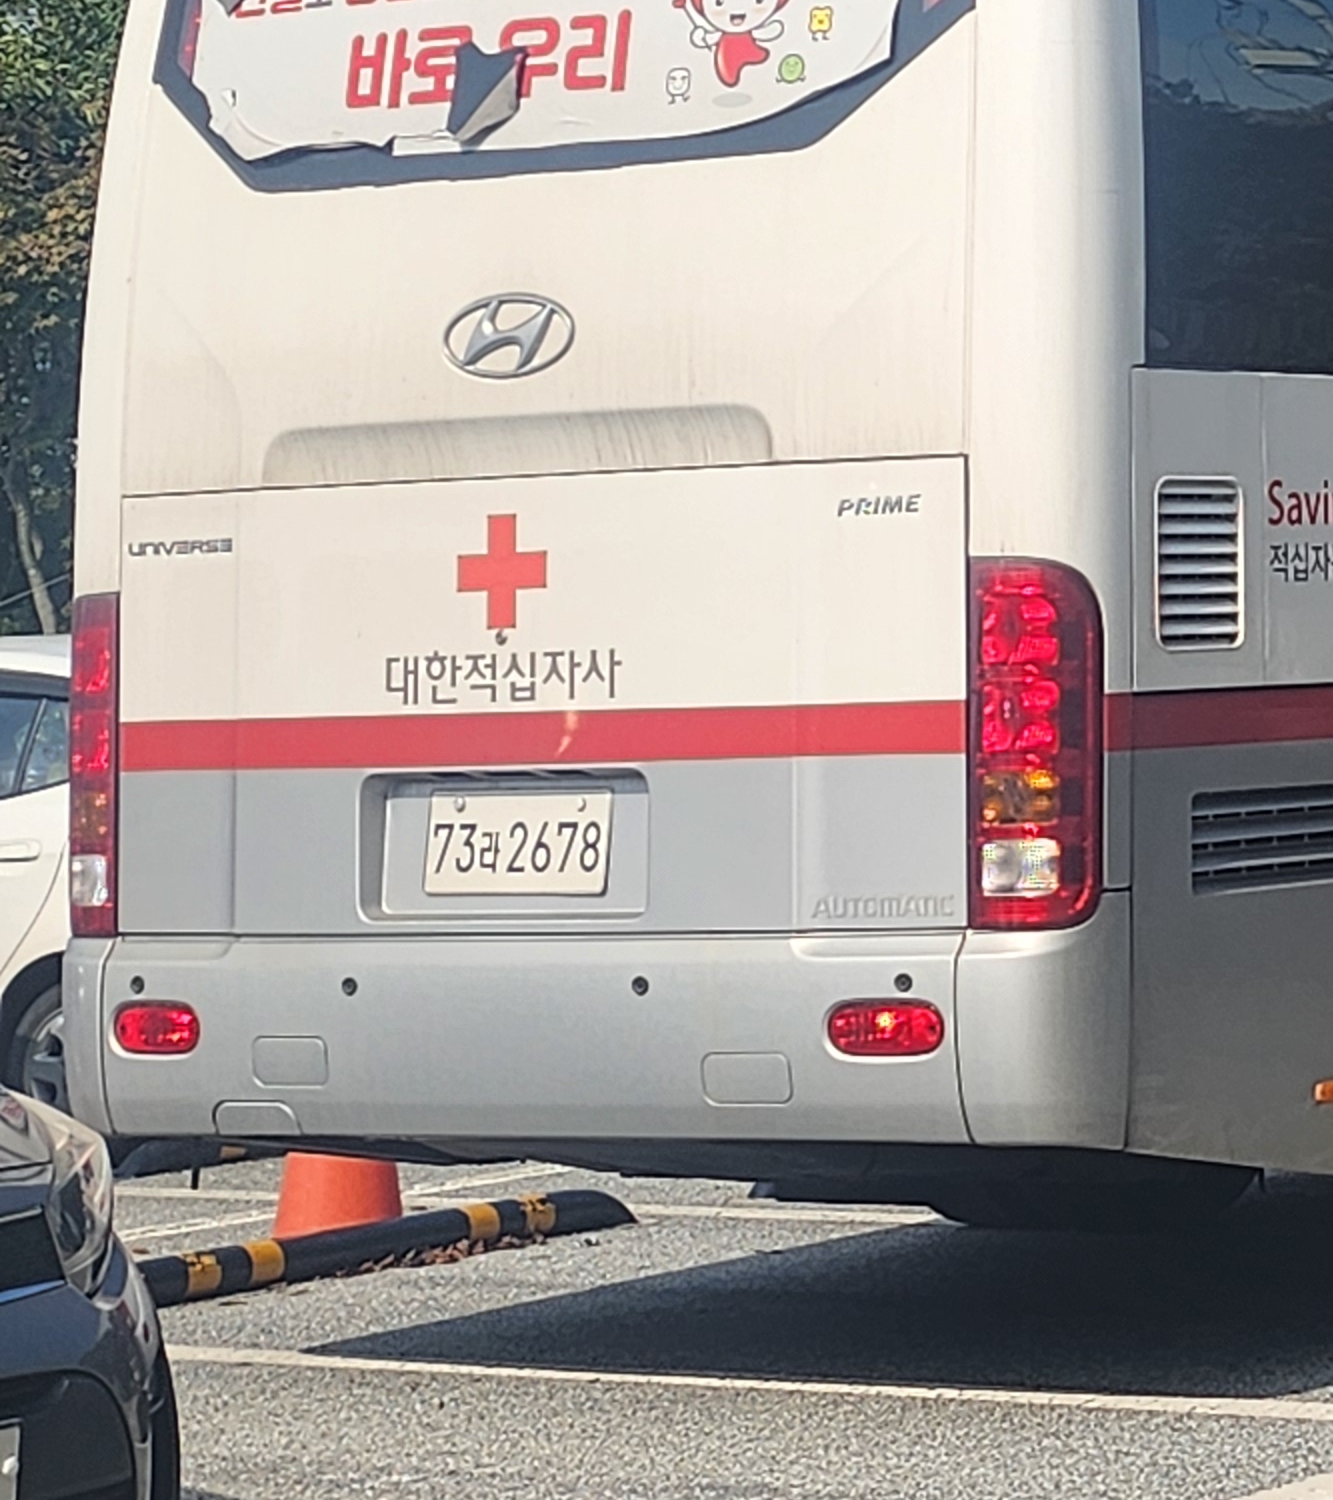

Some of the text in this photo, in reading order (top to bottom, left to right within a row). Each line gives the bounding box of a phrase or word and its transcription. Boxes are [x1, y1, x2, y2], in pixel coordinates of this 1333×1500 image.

[498, 9, 632, 99] 우리
[836, 493, 922, 518] PRIME
[384, 647, 623, 706] 대한적십자사
[433, 820, 602, 875] 73라2678
